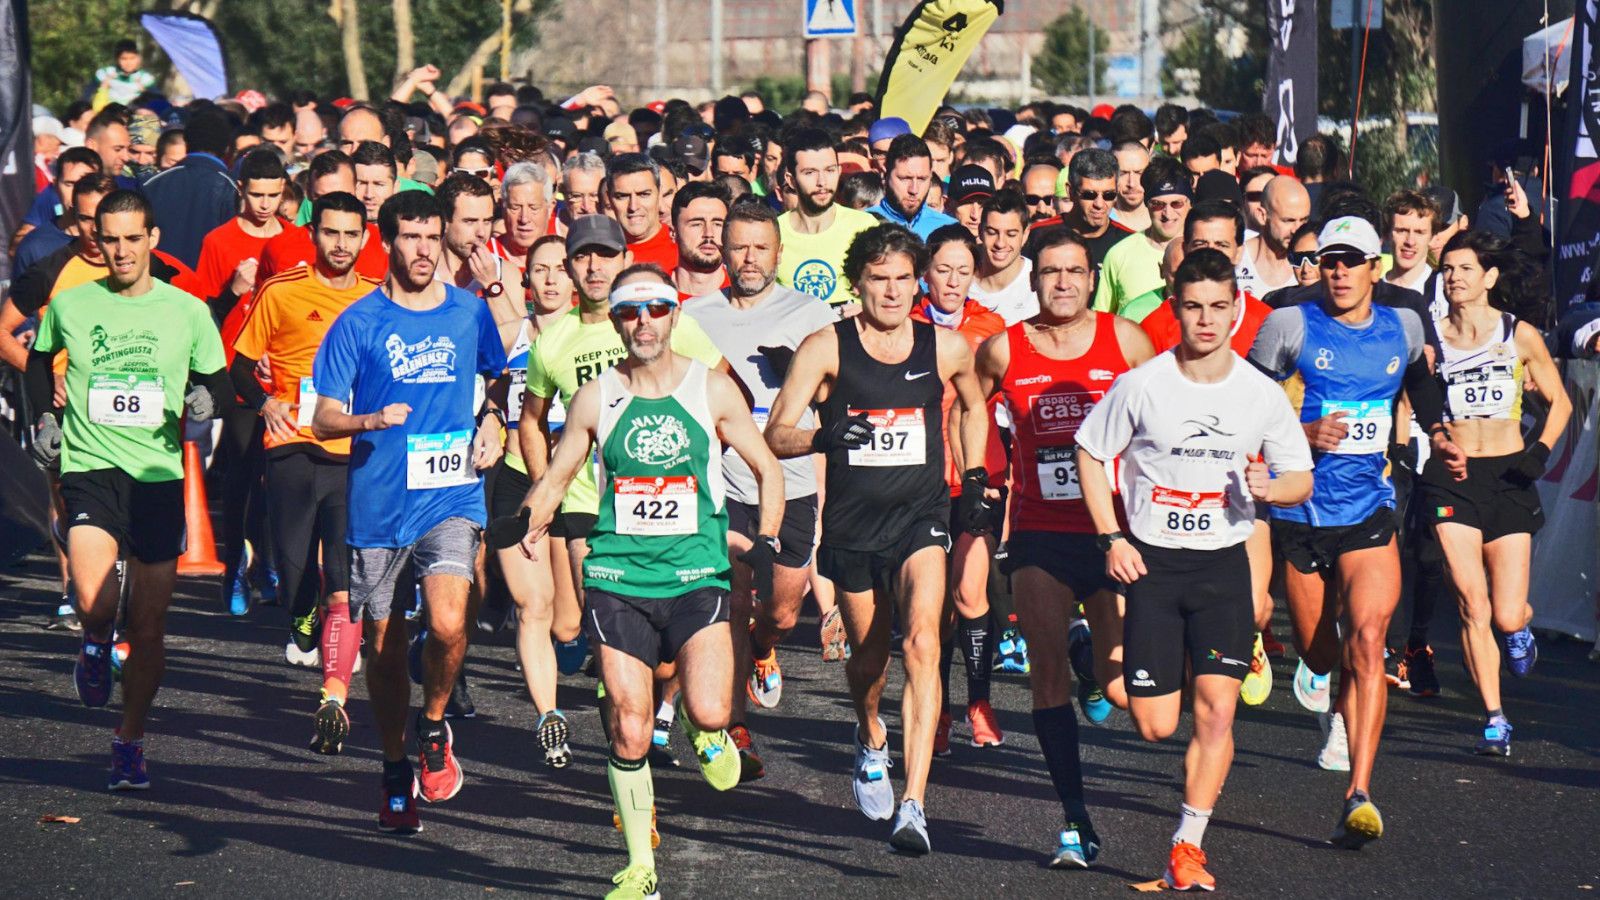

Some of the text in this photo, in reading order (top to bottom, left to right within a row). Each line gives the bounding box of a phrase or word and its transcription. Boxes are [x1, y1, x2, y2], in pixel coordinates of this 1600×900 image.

[92, 346, 152, 367] SPORTINGUISTA
[391, 351, 449, 379] BELENENSE
[574, 351, 602, 364] KEEP
[1038, 395, 1077, 407] espaço
[1464, 386, 1503, 403] 876
[113, 395, 140, 413] 68
[1039, 402, 1094, 419] casa
[1344, 422, 1377, 440] 39
[871, 432, 909, 451] 197
[425, 453, 461, 474] 109
[632, 500, 679, 519] 422
[1167, 511, 1211, 531] 866
